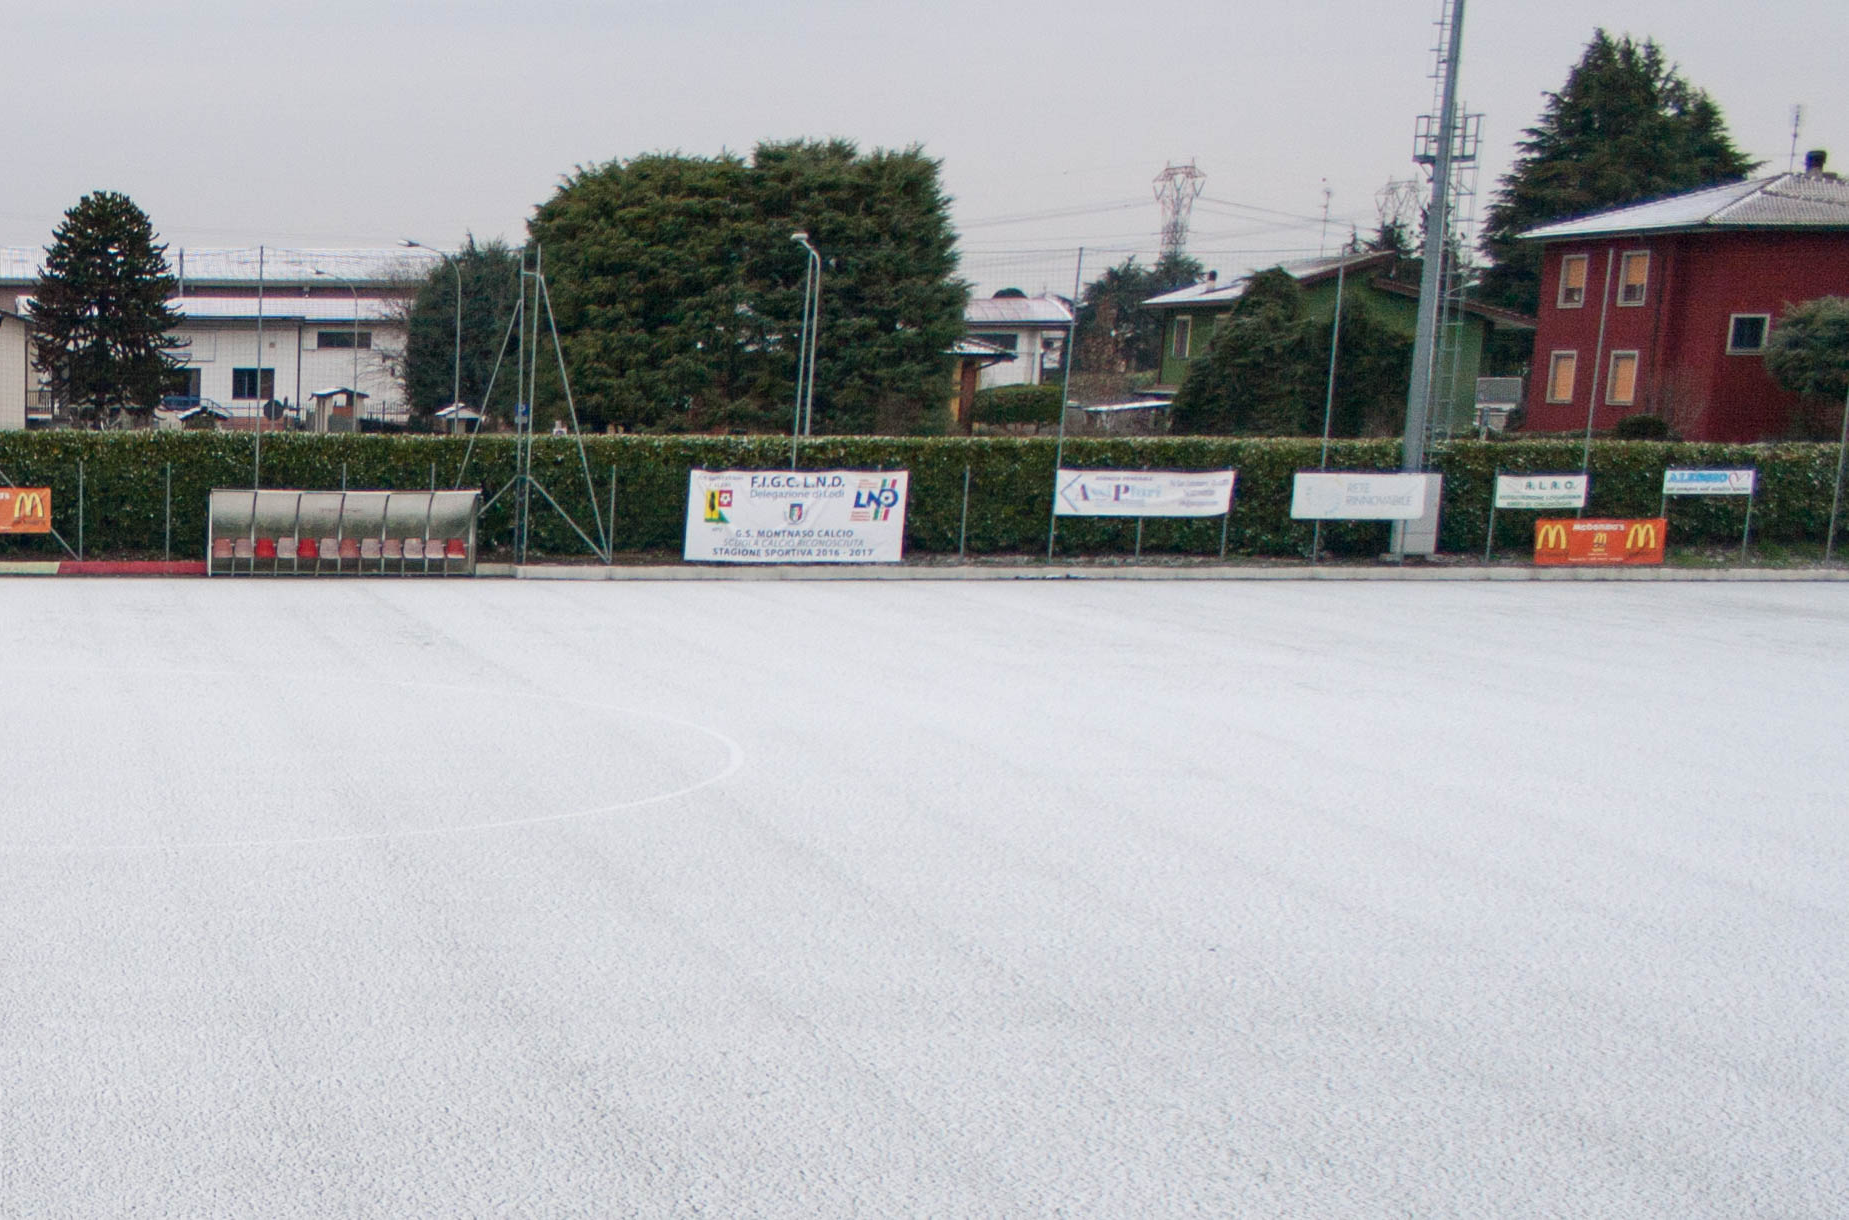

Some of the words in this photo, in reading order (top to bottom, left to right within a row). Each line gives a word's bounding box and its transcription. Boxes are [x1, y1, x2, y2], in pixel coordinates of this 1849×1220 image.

[750, 476, 799, 488] F.I.G.C.
[803, 476, 845, 488] L.N.D.
[750, 489, 810, 499] Delegazione
[736, 529, 754, 538] G.S.
[757, 529, 814, 538] MONTNASO
[817, 529, 854, 538] CALCIO
[712, 548, 761, 557] STAGIONE
[764, 548, 813, 557] SPORTIVA
[816, 548, 840, 557] 2016
[849, 548, 874, 557] 2017
